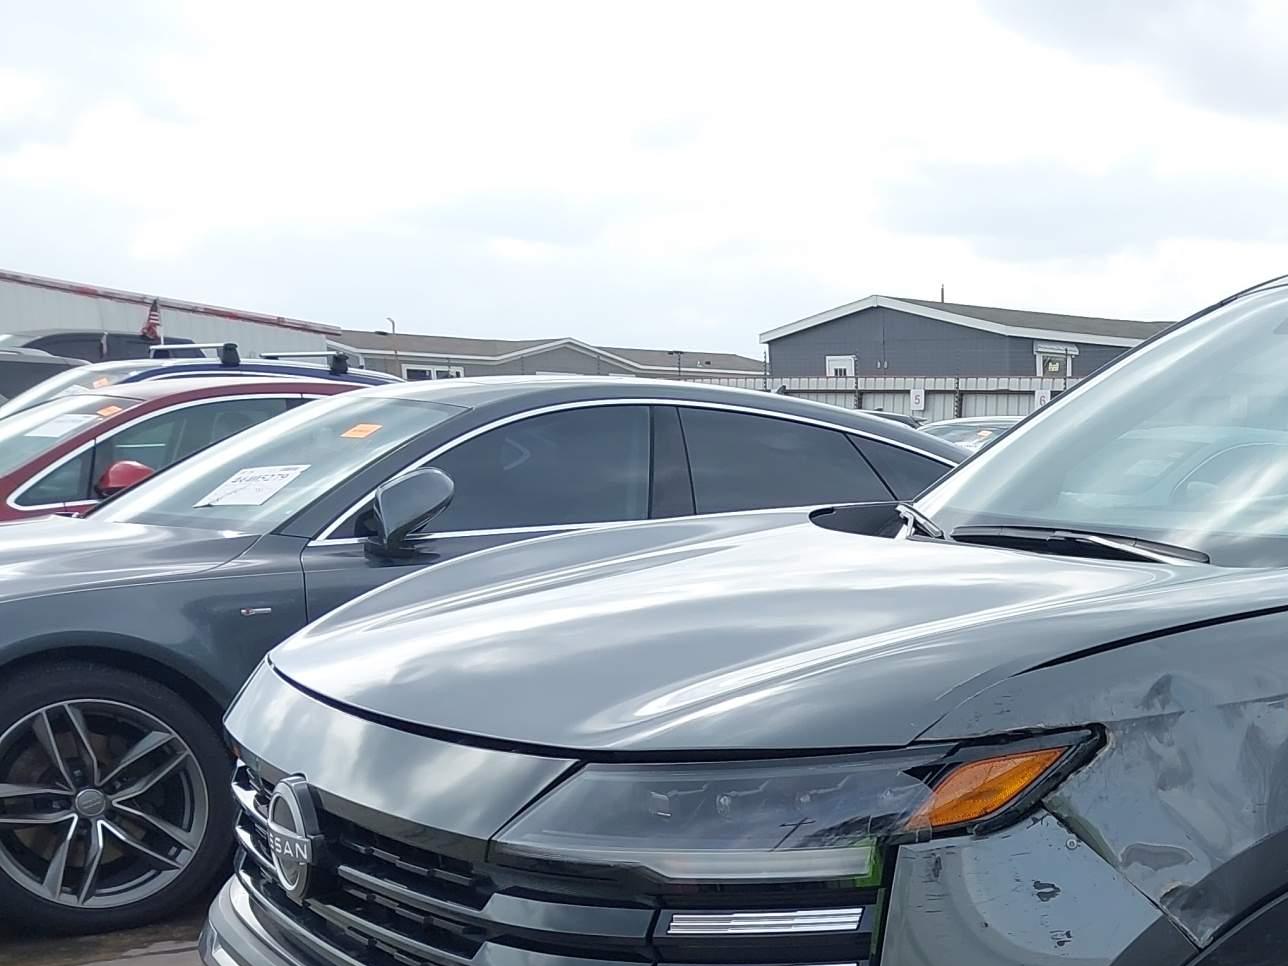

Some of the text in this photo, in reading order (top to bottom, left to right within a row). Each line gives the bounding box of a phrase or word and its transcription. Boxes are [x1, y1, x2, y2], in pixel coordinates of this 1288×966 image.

[914, 394, 921, 405] 5
[1039, 395, 1047, 407] 6
[269, 832, 308, 860] SSAN
